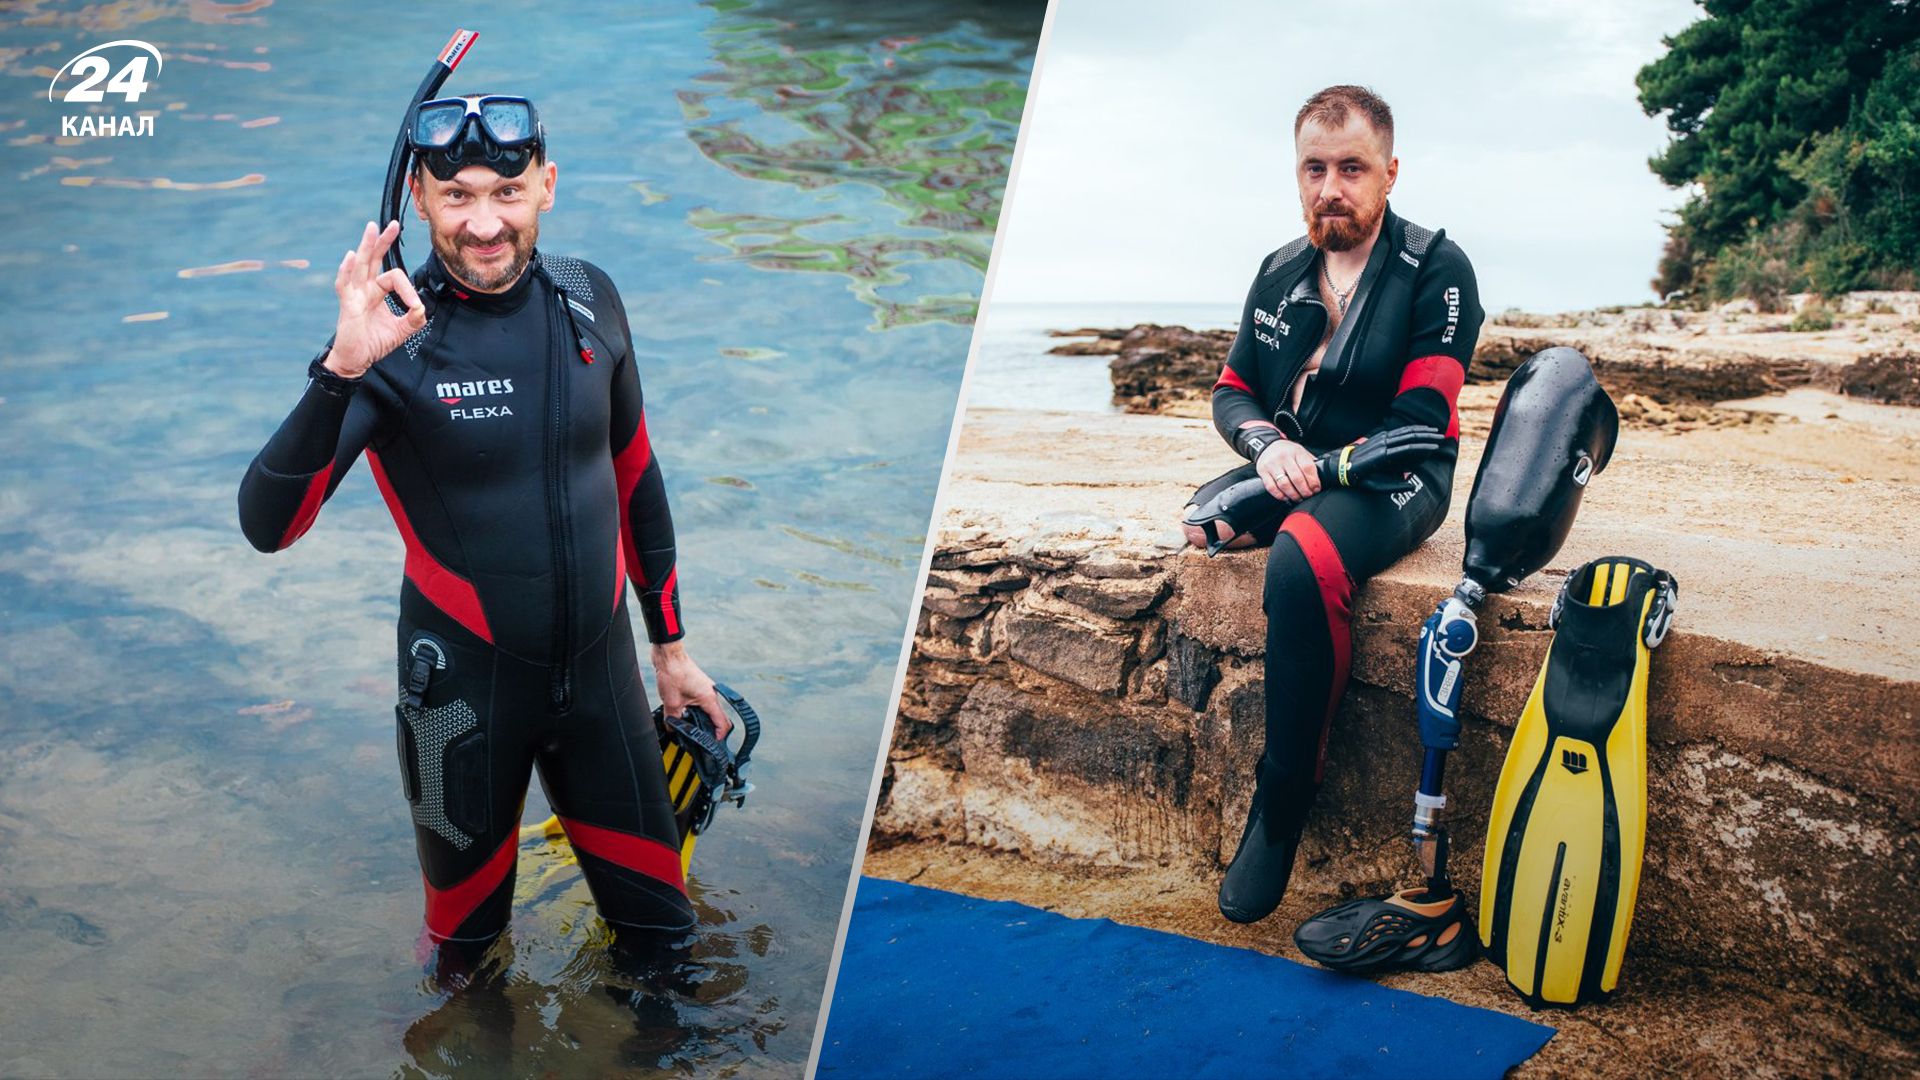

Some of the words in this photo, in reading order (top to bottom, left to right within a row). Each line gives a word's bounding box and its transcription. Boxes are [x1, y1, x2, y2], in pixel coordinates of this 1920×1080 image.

[1442, 286, 1460, 344] mares
[435, 378, 514, 398] mares
[450, 405, 514, 420] FLEXA
